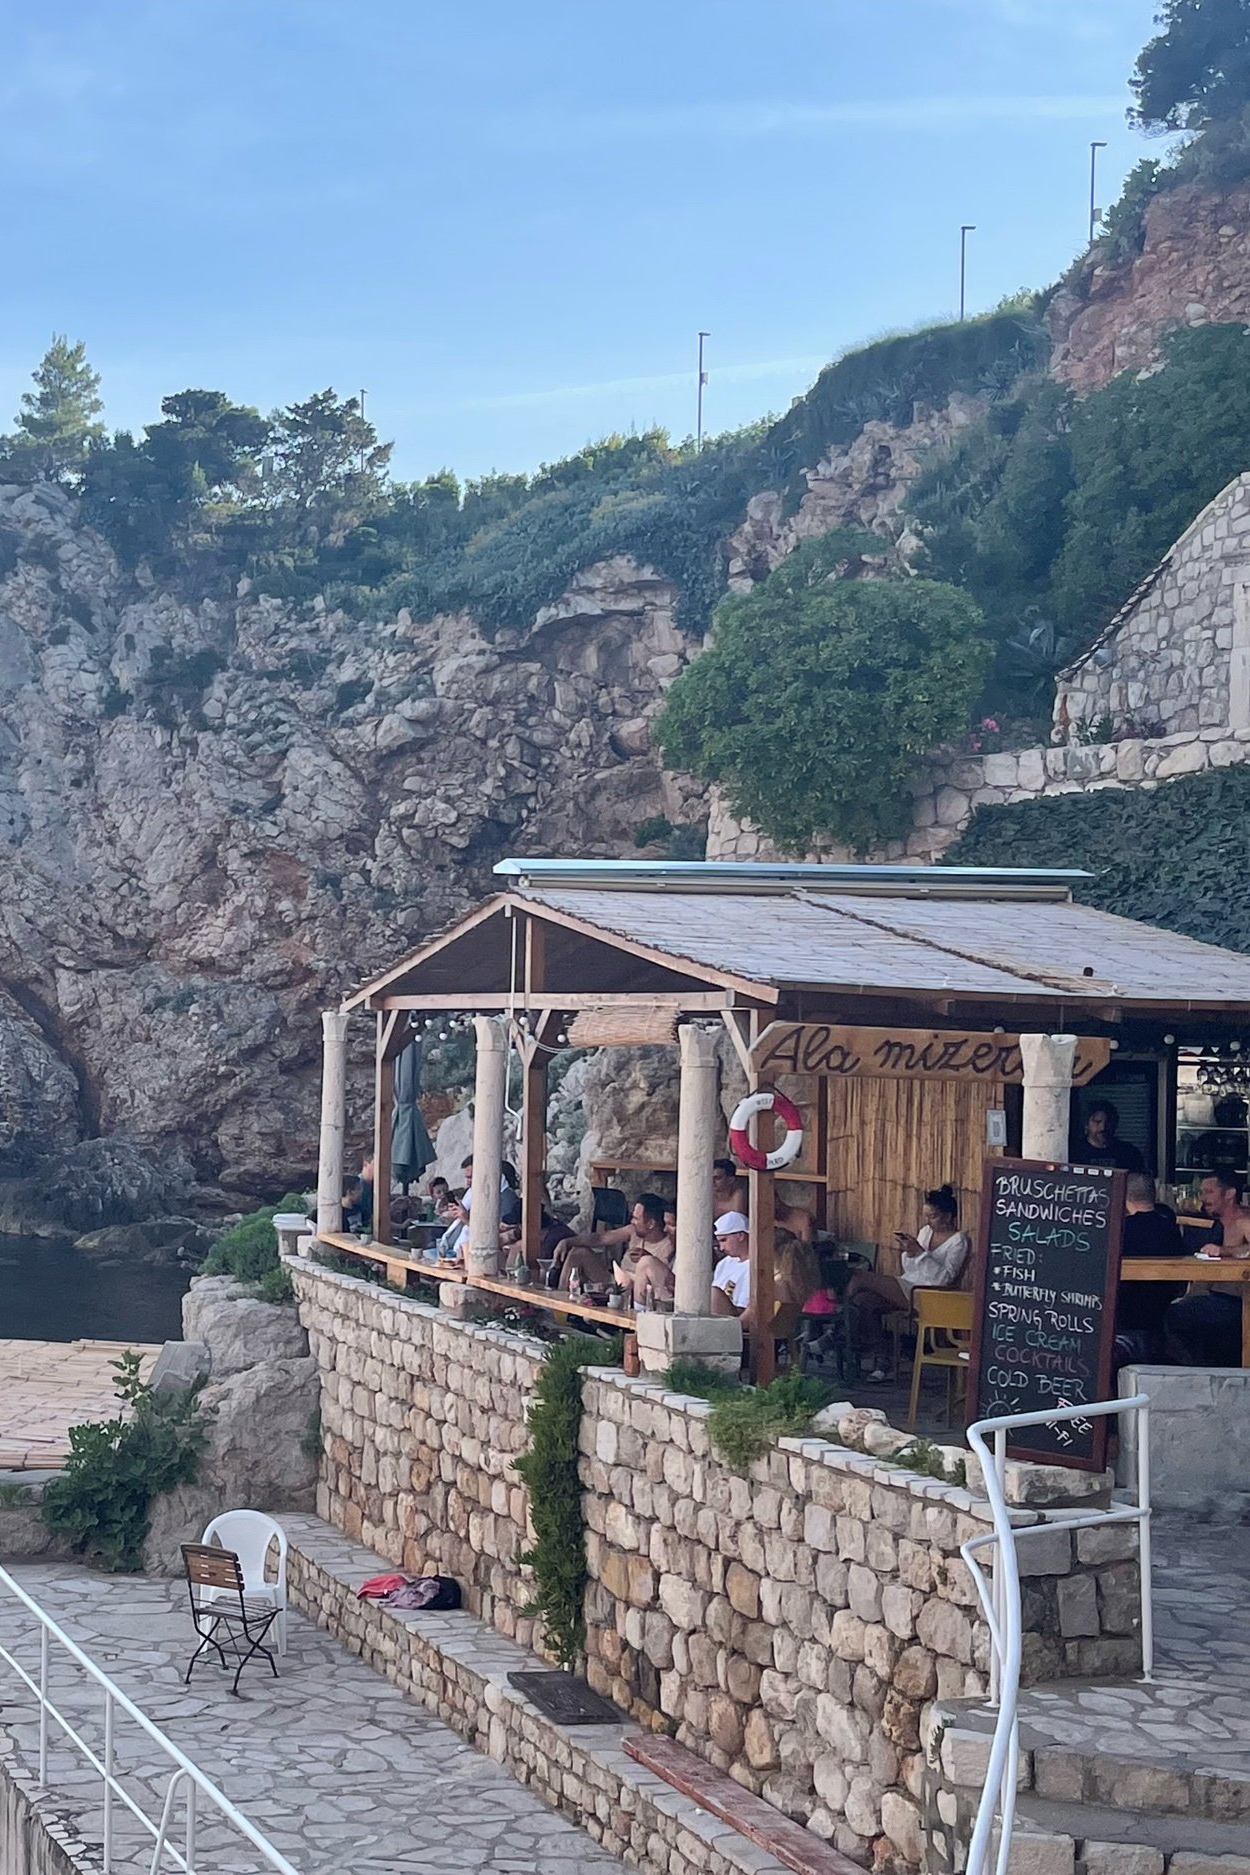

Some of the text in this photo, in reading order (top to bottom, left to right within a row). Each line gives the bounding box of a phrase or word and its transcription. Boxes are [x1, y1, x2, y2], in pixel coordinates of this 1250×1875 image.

[761, 1025, 861, 1073] Ala
[996, 1175, 1110, 1208] BRUSCHETTAS
[996, 1199, 1106, 1228] SANDWICHES
[1008, 1222, 1090, 1251] SALADS
[1002, 1282, 1056, 1309] BUTTERFLY
[989, 1302, 1094, 1333] SPRING ROLLS
[992, 1322, 1081, 1356] ICE CREAM
[995, 1345, 1090, 1377] COCKTAILS
[987, 1366, 1087, 1401] COLD BEER
[1057, 1397, 1093, 1434] FEE
